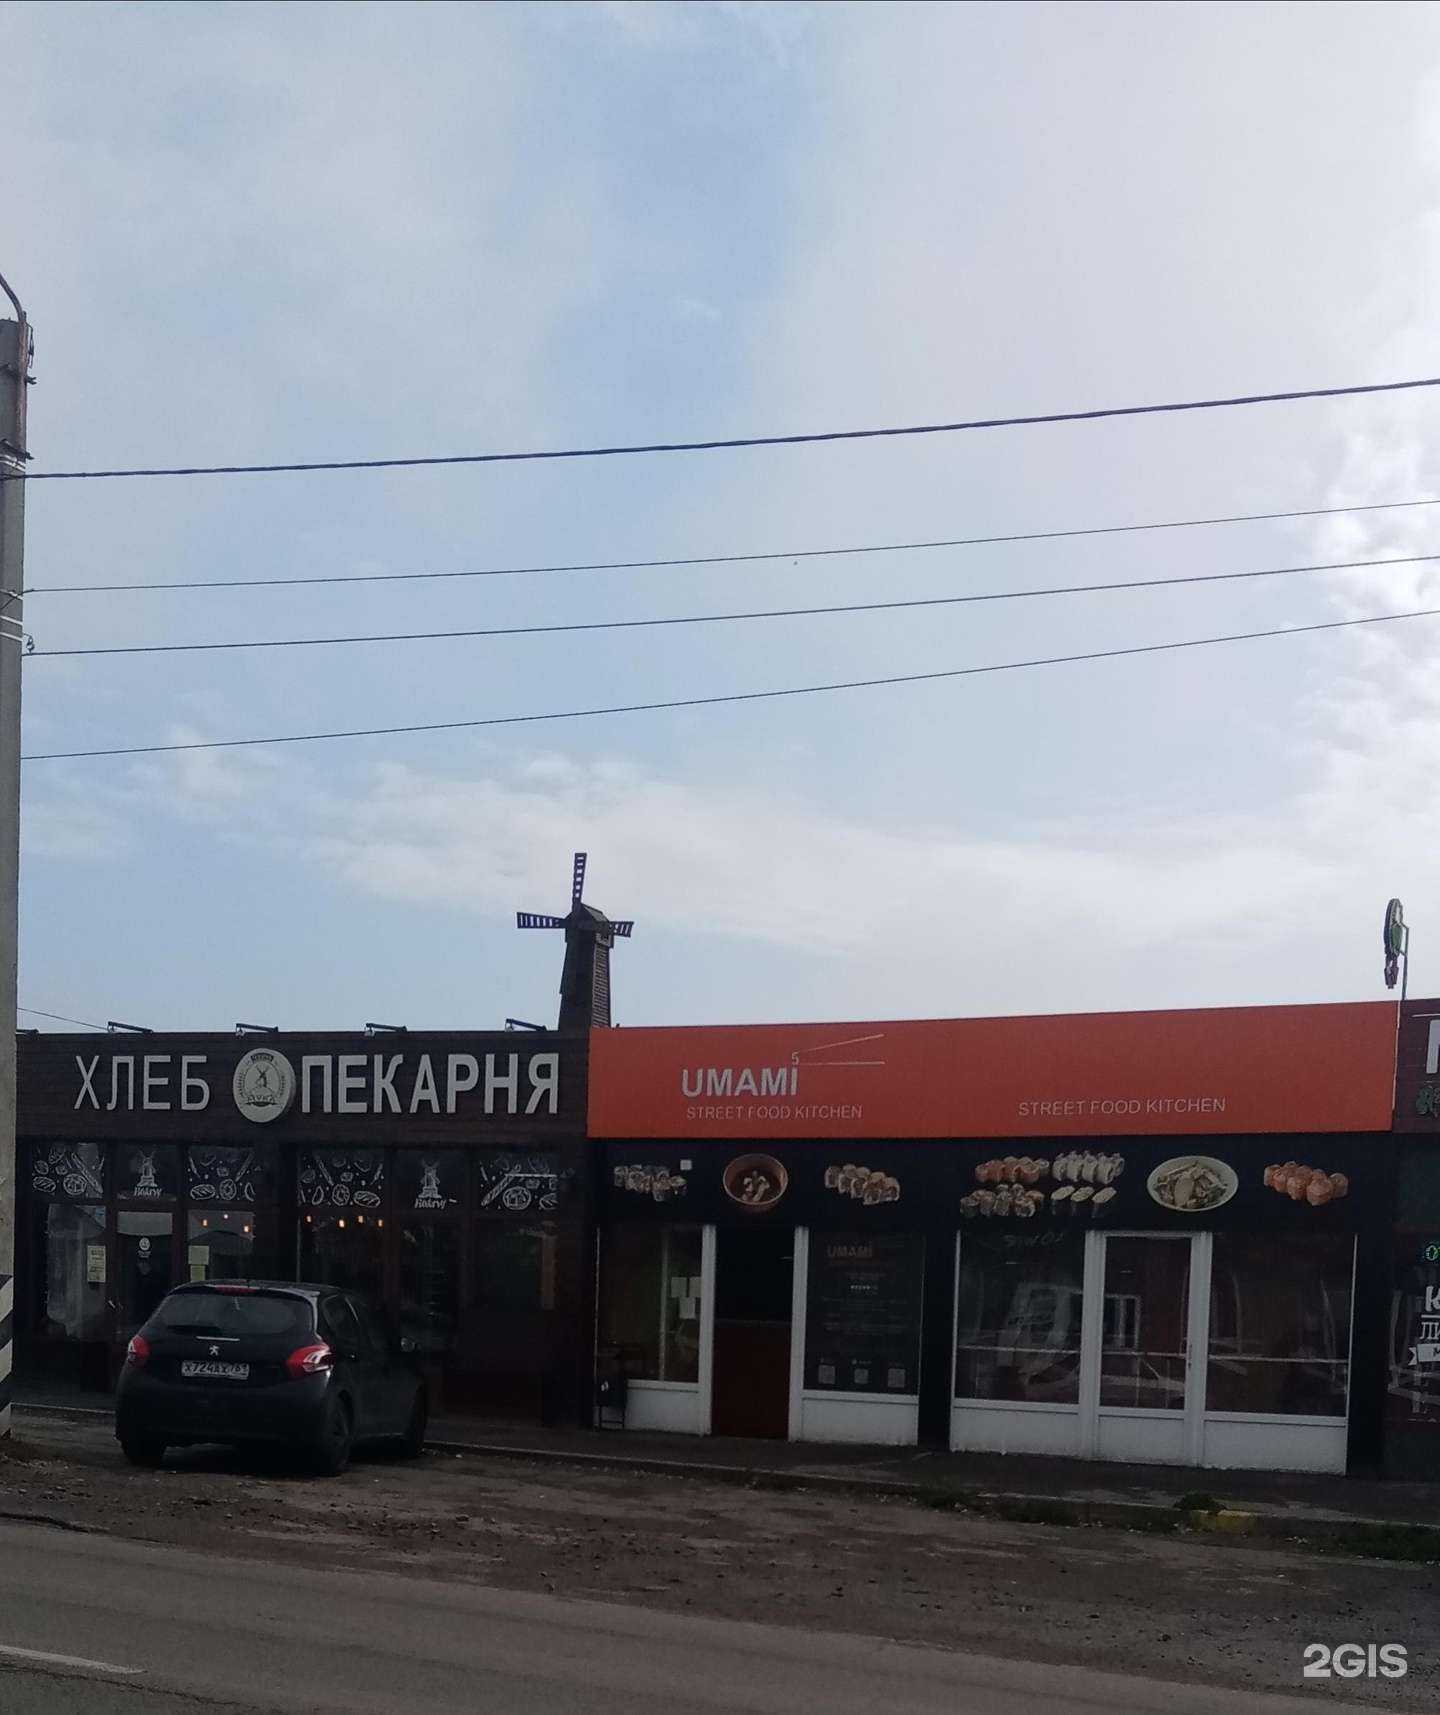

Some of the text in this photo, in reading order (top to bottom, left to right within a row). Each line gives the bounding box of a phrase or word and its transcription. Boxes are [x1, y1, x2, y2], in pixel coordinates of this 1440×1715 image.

[73, 1055, 211, 1111] ХЛЕБ
[301, 1053, 560, 1114] ПЕКАРНЯ
[686, 1103, 863, 1120] STREET FOOD KITCHEN
[1018, 1097, 1227, 1116] STREET FOOD KITCHEN
